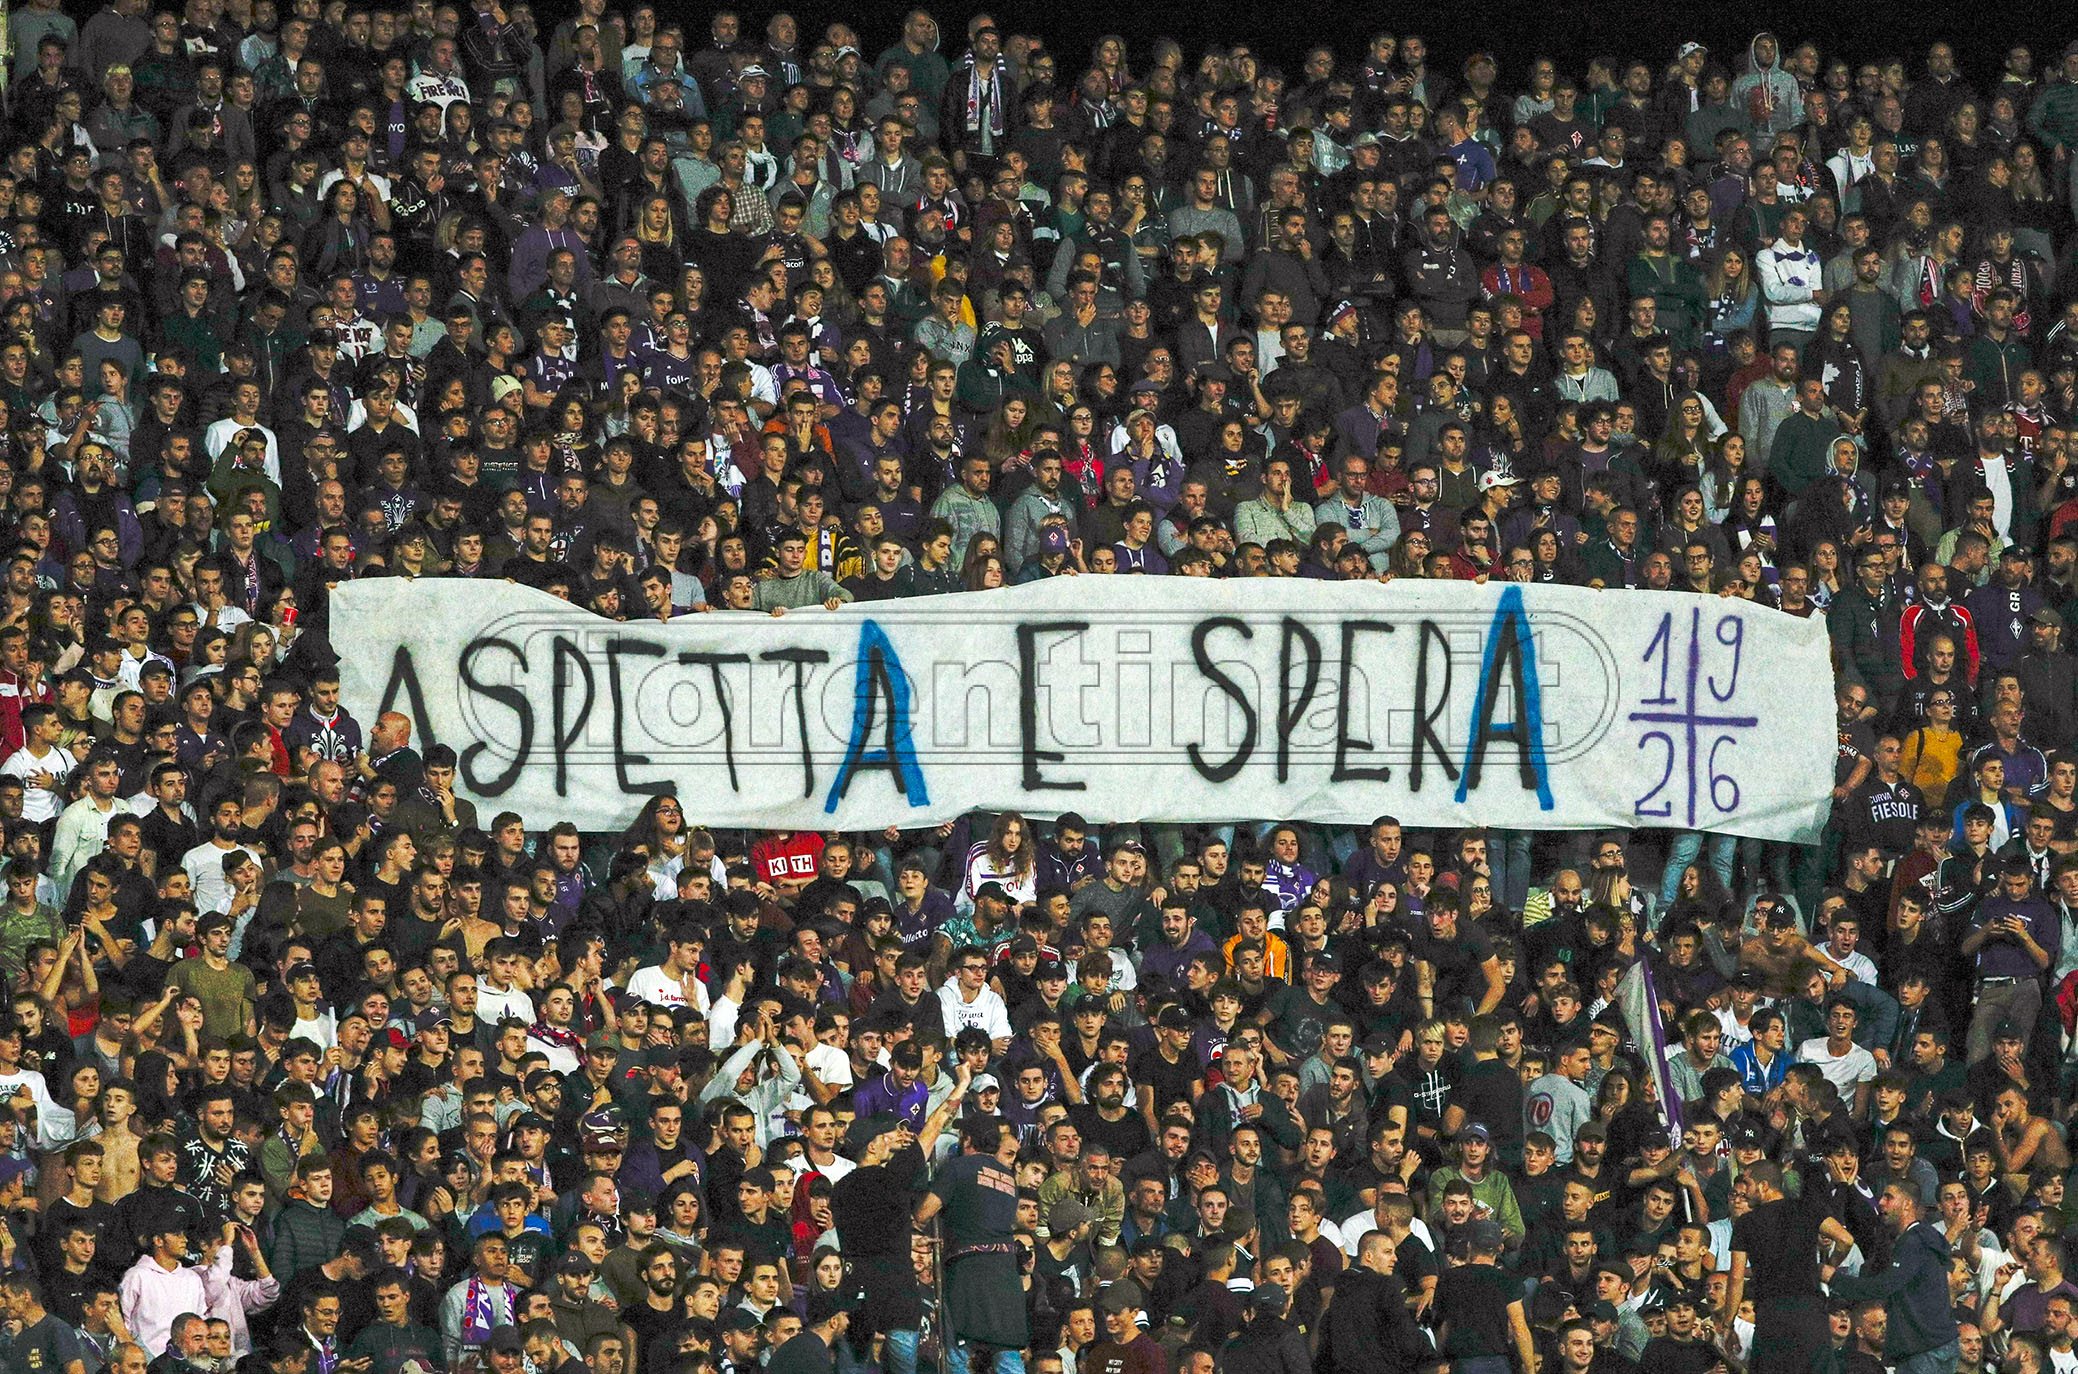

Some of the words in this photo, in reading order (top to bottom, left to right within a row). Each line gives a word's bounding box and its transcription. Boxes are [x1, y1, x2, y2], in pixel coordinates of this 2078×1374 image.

[379, 618, 930, 814] ASPETTA
[1016, 621, 1090, 791] E
[1186, 585, 1555, 812] SPERA
[1869, 791, 1893, 804] CURVA
[1871, 801, 1919, 823] FIESOLE
